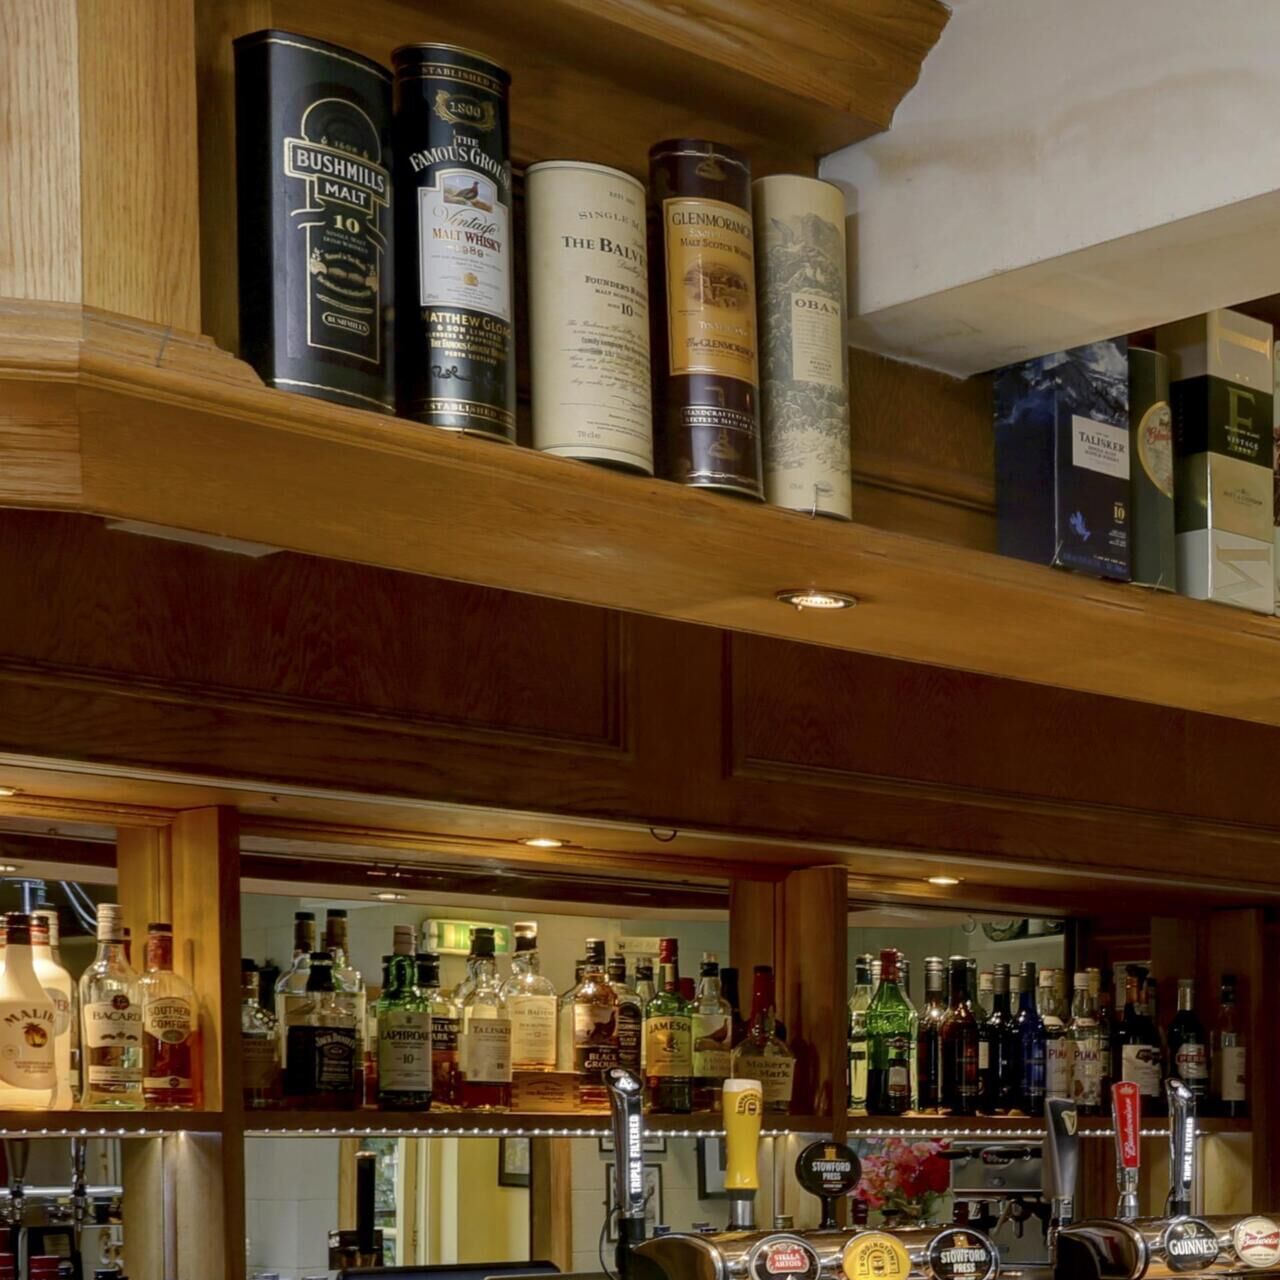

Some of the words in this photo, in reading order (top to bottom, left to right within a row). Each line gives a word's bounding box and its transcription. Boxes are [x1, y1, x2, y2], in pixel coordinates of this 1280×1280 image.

[456, 135, 479, 147] THE
[409, 146, 468, 172] FAMOUS
[296, 149, 385, 193] BUSHMILLS
[325, 181, 366, 205] MALT
[334, 214, 360, 234] 10
[433, 207, 498, 237] Vintage
[579, 211, 629, 225] SINGLE
[432, 228, 462, 242] MALT
[465, 231, 502, 253] WHISKY
[562, 236, 596, 250] THE
[680, 238, 701, 248] MALT
[621, 302, 634, 317] 10
[794, 298, 839, 316] OBAN
[421, 310, 480, 327] MATTHEW
[1078, 431, 1126, 454] TALISKER
[1114, 506, 1127, 520] 10
[402, 1054, 414, 1065] 10
[589, 1052, 617, 1061] BLACK
[746, 1060, 791, 1069] Maker's
[760, 1069, 790, 1078] Mark
[628, 1113, 641, 1158] FILTERED
[1123, 1097, 1137, 1159] Budweiser
[1184, 1116, 1194, 1153] FILTERED
[811, 1161, 851, 1173] STOWFORD
[1183, 1154, 1193, 1181] TRIPLE
[629, 1159, 642, 1195] TRIPLE
[822, 1172, 841, 1181] PRESS
[1169, 1238, 1219, 1256] GUINNESS
[773, 1253, 801, 1261] STELLA
[775, 1260, 802, 1268] ARTOIS
[859, 1241, 897, 1271] BODDINGTONS
[940, 1249, 986, 1264] STOWFORD
[953, 1263, 976, 1273] PRESS
